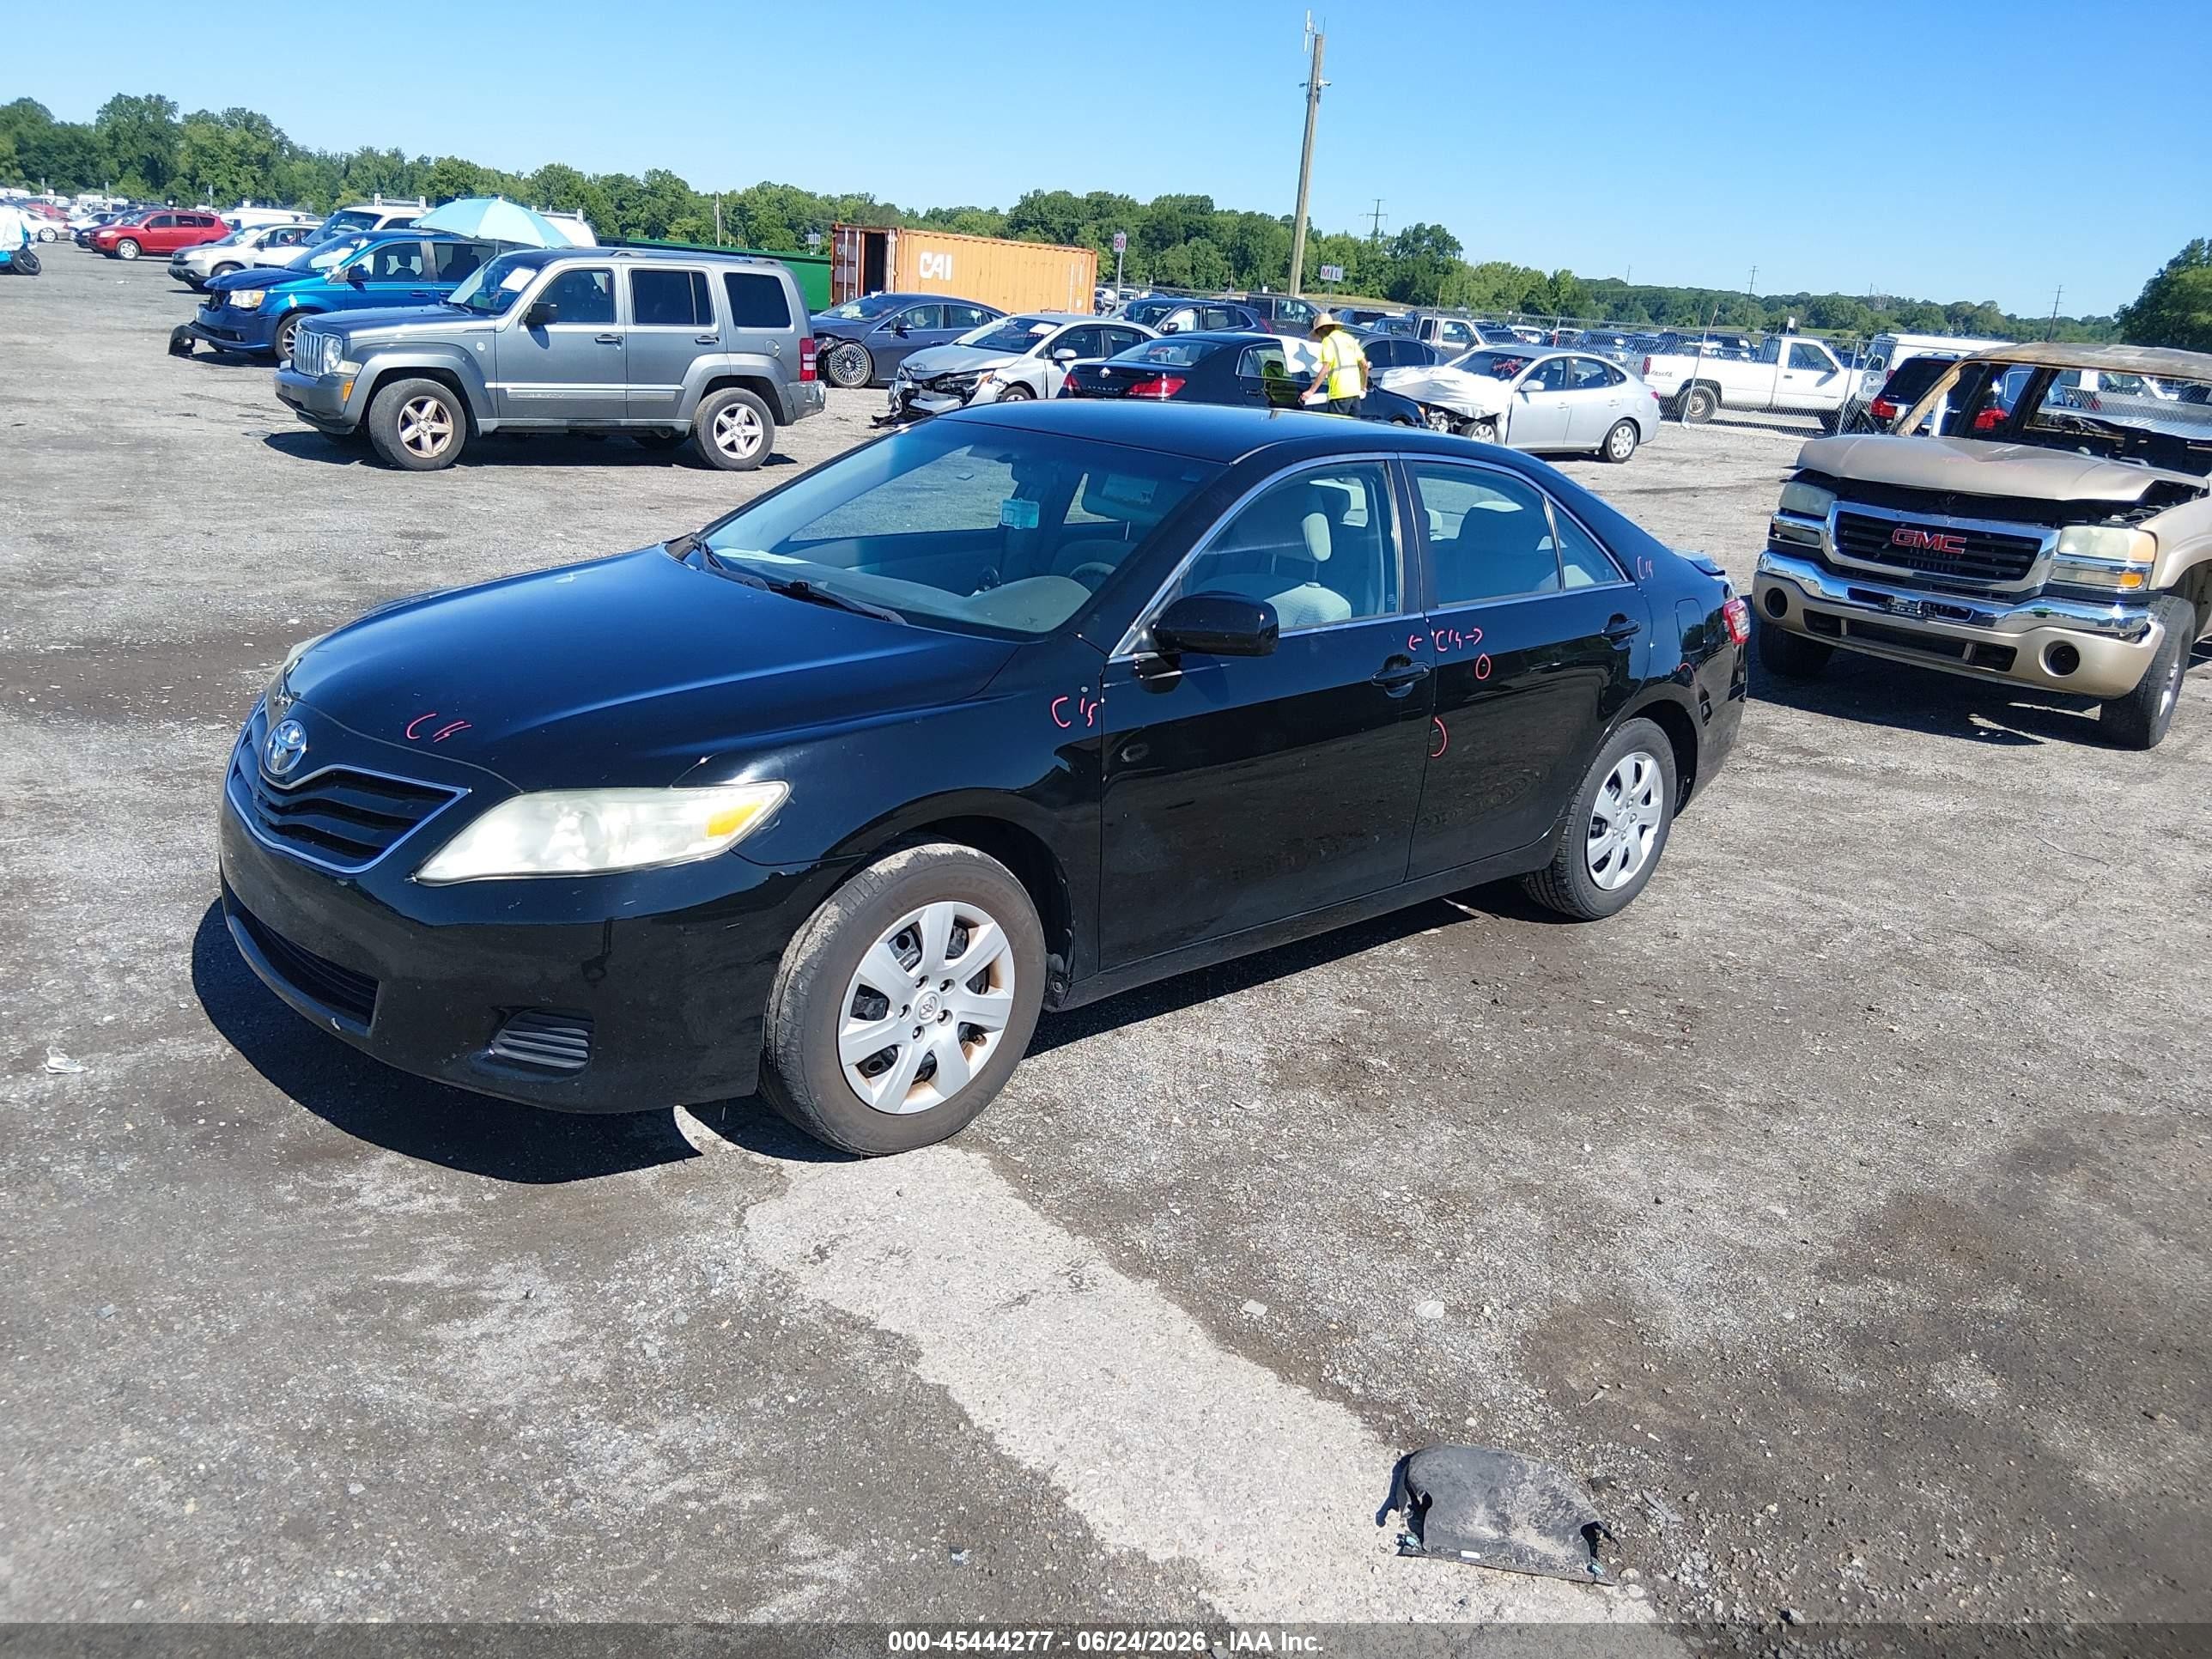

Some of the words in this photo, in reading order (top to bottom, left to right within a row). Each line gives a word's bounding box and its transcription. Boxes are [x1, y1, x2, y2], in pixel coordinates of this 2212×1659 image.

[1115, 237, 1125, 248] 50
[919, 251, 954, 281] CAI
[1892, 528, 1968, 554] GMC
